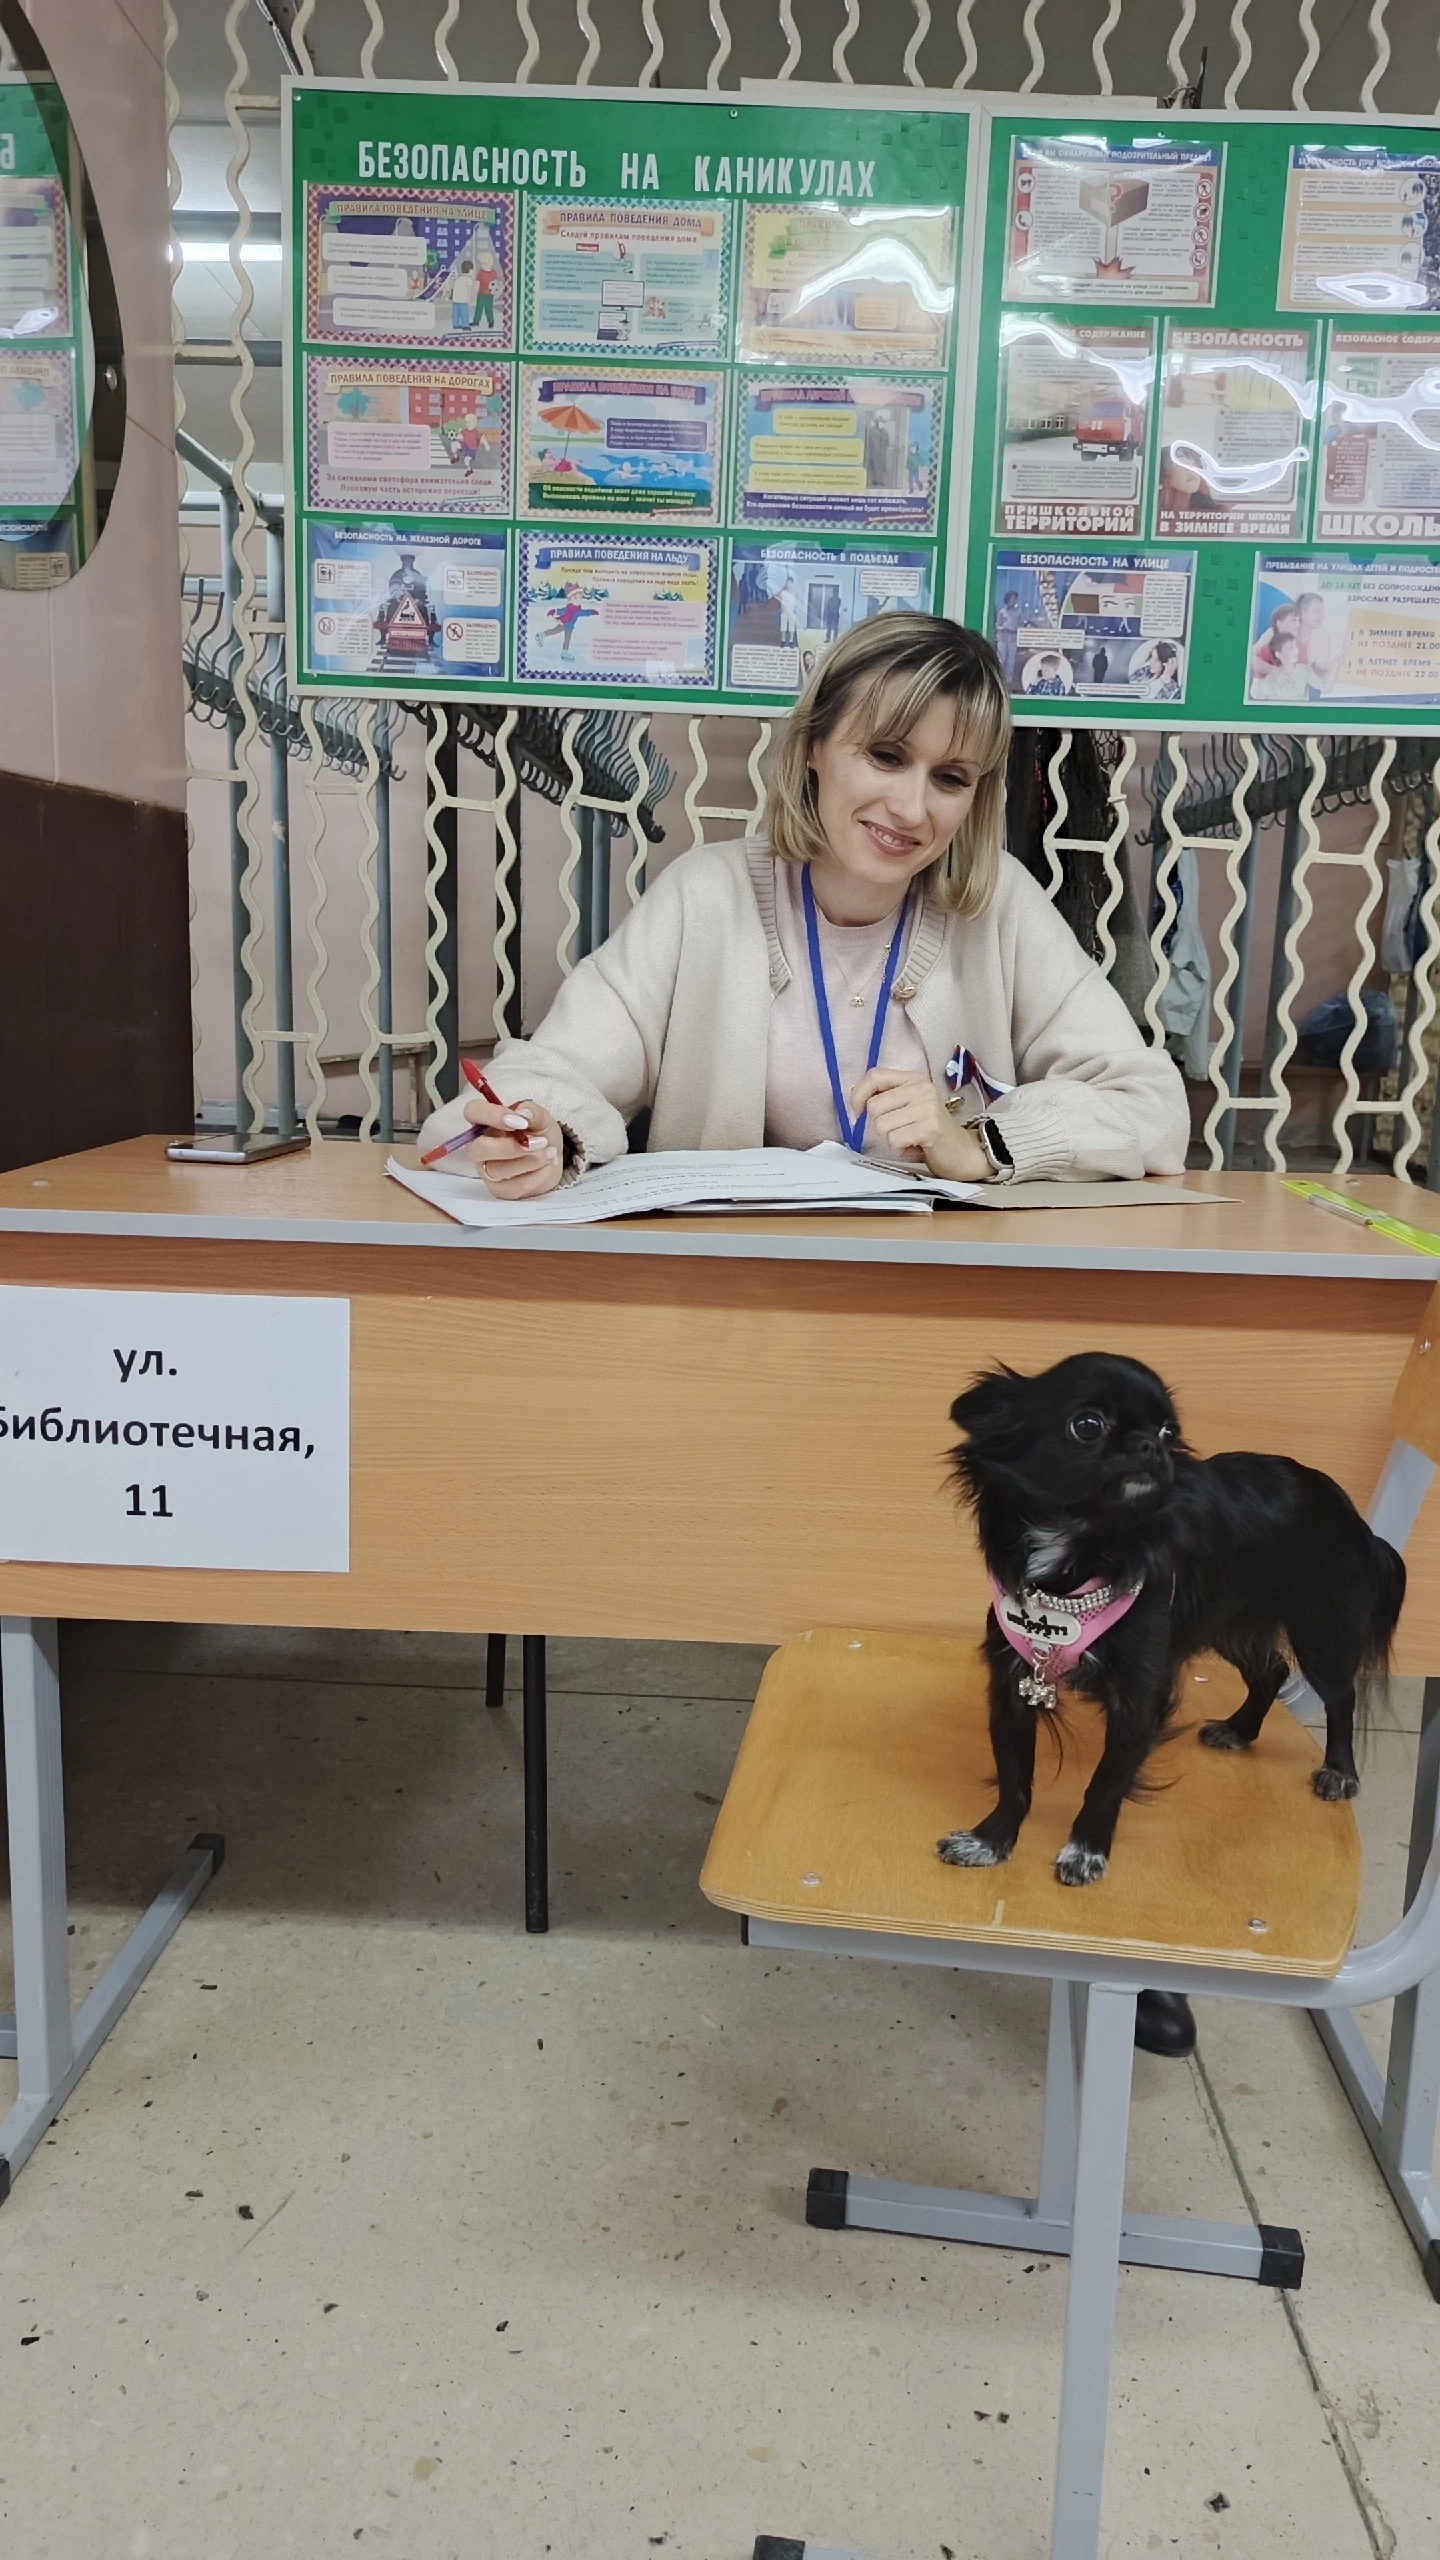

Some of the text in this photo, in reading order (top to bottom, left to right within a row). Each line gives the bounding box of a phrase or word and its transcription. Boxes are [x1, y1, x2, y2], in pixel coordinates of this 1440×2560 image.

[358, 141, 875, 197] БЕЗОПАСНОСТЬ НА КАНИКУЛАХ
[337, 204, 487, 219] ПРАВИЛА ПОВЕДЕНИЯ НА УЛИЦЕ
[560, 213, 702, 228] ПРАВИЛА ПОВЕДЕНИЯ ДОМА
[561, 229, 588, 239] Следуй
[591, 232, 629, 240] правилам
[632, 233, 674, 242] поведения
[1079, 329, 1146, 339] СОДЕРЖАНИЕ
[1172, 331, 1304, 347] БЕЗОПАСНОСТЬ
[1336, 334, 1398, 344] БЕЗОПАСНОЕ
[331, 374, 490, 388] ПРАВИЛА ПОВЕДЕНИЯ НА ДОРОГАХ
[1004, 504, 1135, 517] ПРИШКОЛЬНОЙ
[1160, 511, 1291, 521] НА ТЕРРИТОРИИ ШКОЛЫ
[1004, 515, 1134, 532] ТЕРРИТОРИИ
[1159, 521, 1290, 535] В ЗИМНЕЕ ВРЕМЯ
[334, 531, 482, 546] БЕЗОПАСНОСТЬ НА ЖЕЛЕЗНОЙ ДОРОГЕ
[550, 549, 689, 564] ПРАВИЛА ПОВЕДЕНИЯ НА ЛЬДУ
[760, 549, 899, 564] БЕЗОПАСНОСТЬ В ПОДЪЕЗДЕ
[1020, 554, 1170, 569] БЕЗОПАСНОСТЬ НА УЛИЦЕ
[1265, 561, 1315, 570] ПРЕБЫВАНИЕ
[1331, 564, 1363, 572] УЛИЦАХ
[1364, 564, 1388, 572] ДЕТЕЙ
[1347, 595, 1390, 603] ВЗРОСЛЫХ
[1369, 629, 1403, 637] ЗИМНЕЕ
[1407, 630, 1435, 638] ВРЕМЯ
[1358, 640, 1368, 648] НЕ
[1372, 640, 1412, 649] ПОЗДНЕЕ
[1368, 658, 1398, 666] ЛЕТНЕЕ
[1402, 659, 1431, 667] ВРЕМЯ
[1356, 668, 1368, 676] НЕ
[1370, 669, 1411, 678] ПОЗДНЕЕ
[113, 1349, 178, 1383] ул.
[125, 1484, 173, 1517] 11
